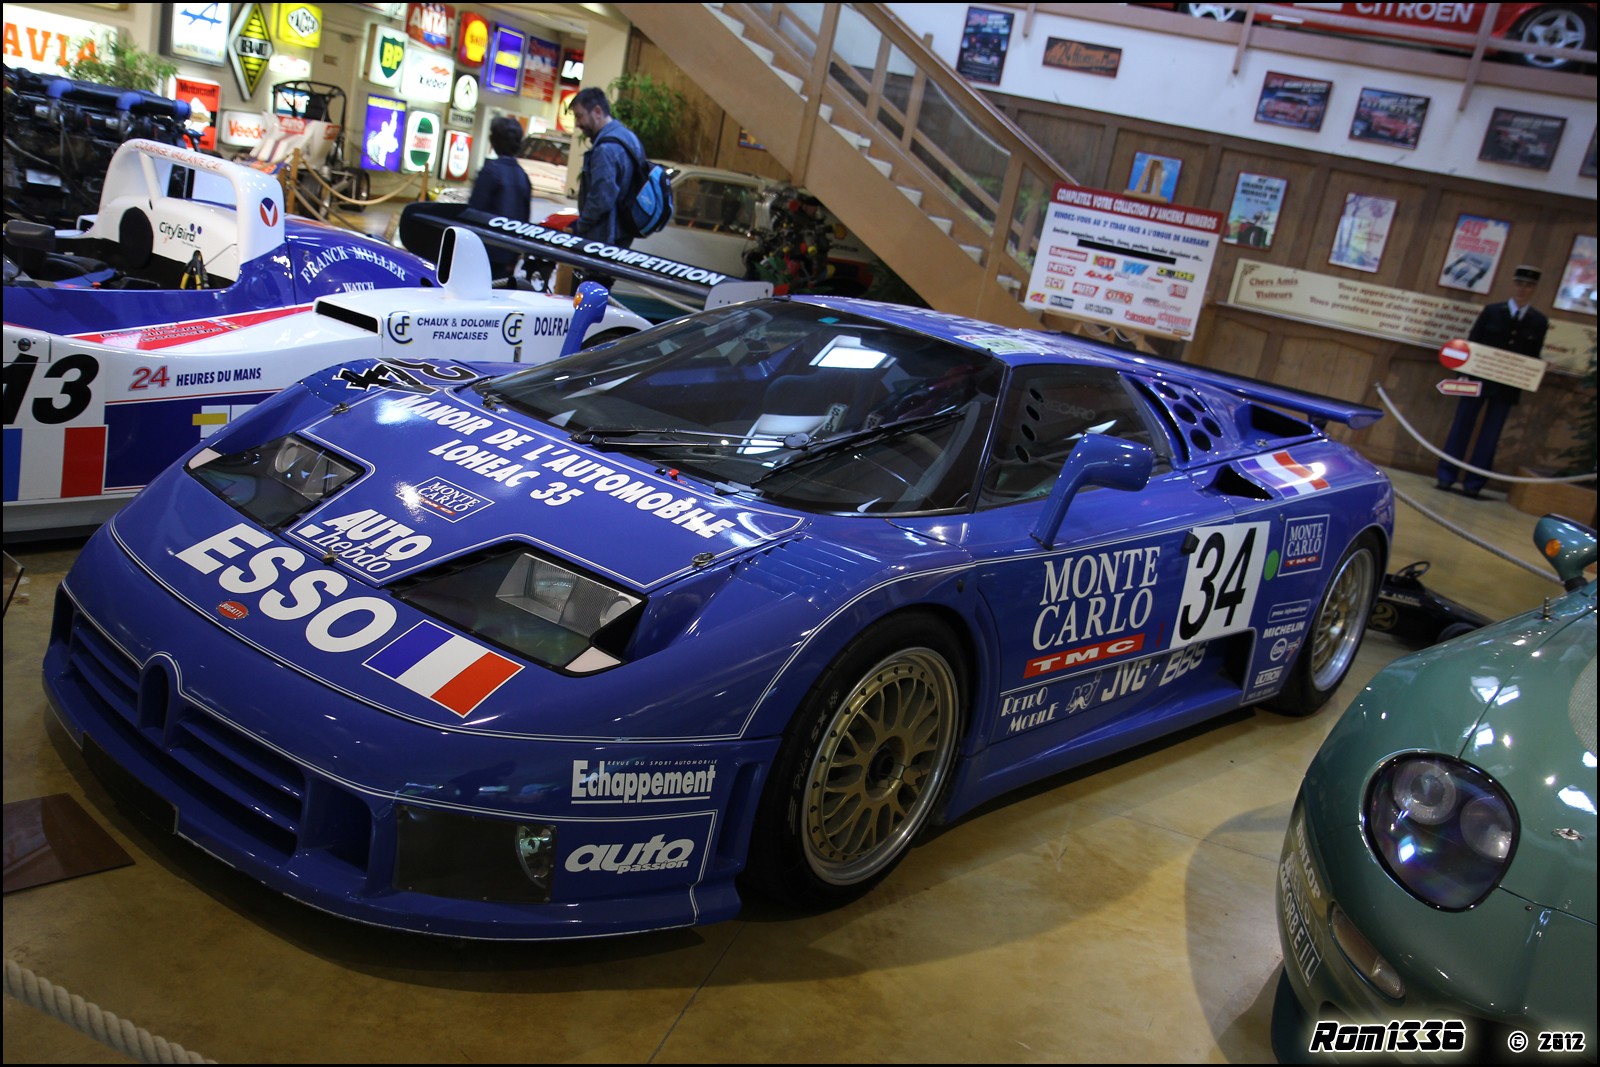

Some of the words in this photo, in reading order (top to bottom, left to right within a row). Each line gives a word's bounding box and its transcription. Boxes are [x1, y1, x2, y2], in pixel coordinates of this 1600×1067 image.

[382, 41, 404, 70] BP
[1054, 211, 1092, 224] RENDEZ-VOUS
[1113, 198, 1150, 217] COLLECTION
[300, 246, 349, 284] FRANCK
[488, 215, 581, 248] COURAGE
[583, 241, 726, 287] COMPETITION
[343, 282, 375, 293] WATCH
[1276, 277, 1298, 286] Amis
[417, 317, 449, 327] CHAUX
[452, 318, 458, 327] &
[460, 318, 499, 328] DOLOMIE
[432, 331, 488, 341] FRANCAISES
[3, 353, 99, 425] 13
[128, 365, 170, 392] 24
[176, 371, 215, 386] HEURES
[218, 370, 232, 382] DU
[233, 368, 262, 381] MANS
[394, 393, 495, 436] MANOIR
[482, 427, 529, 451] DE
[522, 444, 737, 538] L'AUTOMOBILE
[428, 439, 542, 488] LOHEAC
[529, 481, 585, 507] 35
[418, 487, 469, 512] CARLO
[428, 481, 481, 507] MONTE
[322, 508, 432, 562] AUTO
[1286, 537, 1322, 557] CARLO
[1289, 522, 1323, 541] MONTE
[313, 528, 392, 573] hebdo
[1286, 556, 1316, 565] TMC
[175, 522, 398, 653] ESSO
[1040, 546, 1161, 606] MONTE
[1179, 527, 1257, 641] 34
[1032, 588, 1153, 651] CARLO
[1262, 621, 1305, 639] MICHELIN
[1033, 640, 1135, 672] TMC
[1101, 657, 1153, 702] JVC
[1159, 646, 1206, 687] BBS
[1007, 702, 1060, 735] MOBILE
[571, 759, 716, 803] Echappement
[564, 833, 695, 873] auto
[616, 859, 689, 874] passion
